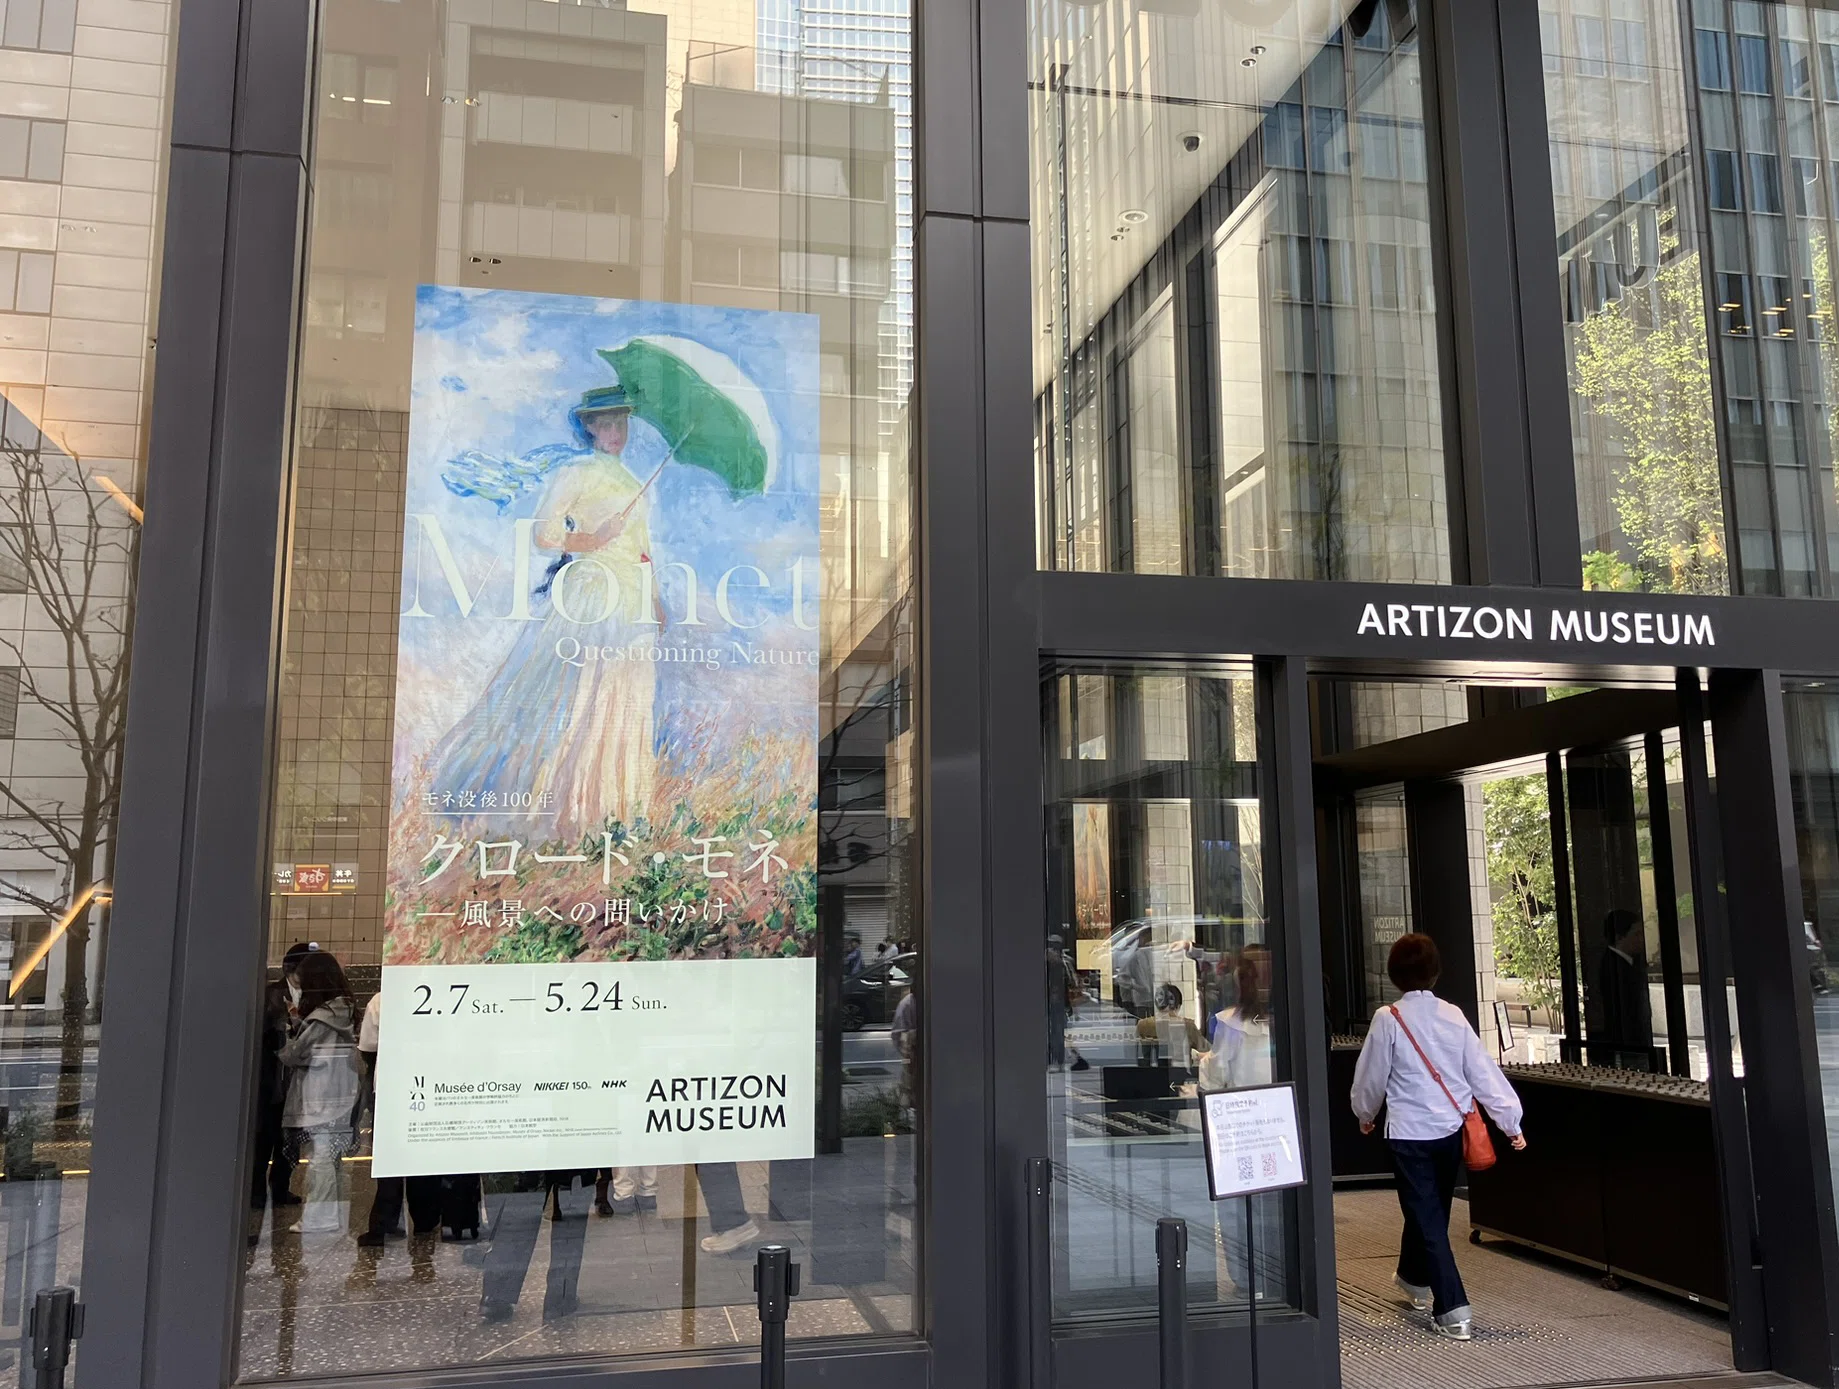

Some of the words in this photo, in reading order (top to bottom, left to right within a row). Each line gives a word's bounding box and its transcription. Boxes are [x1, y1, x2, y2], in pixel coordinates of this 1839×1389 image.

[400, 512, 819, 631] Monet
[1357, 603, 1532, 640] ARTIZON
[1550, 609, 1715, 646] MUSEUM
[555, 636, 722, 670] Questioning
[730, 641, 819, 665] Nature
[422, 790, 554, 809] モネ没後100年
[418, 829, 789, 886] クロード・モネ
[412, 984, 470, 1015] 2.7
[471, 999, 504, 1014] Sat.
[545, 980, 624, 1012] 5.24
[632, 995, 668, 1010] Sun.
[434, 1082, 474, 1094] Musée
[477, 1081, 522, 1093] d'Orsay
[534, 1081, 570, 1091] NIKKEI
[601, 1080, 628, 1089] NHK
[645, 1074, 786, 1103] ARTIZON
[409, 1101, 426, 1112] 40
[645, 1104, 787, 1133] MUSEUM
